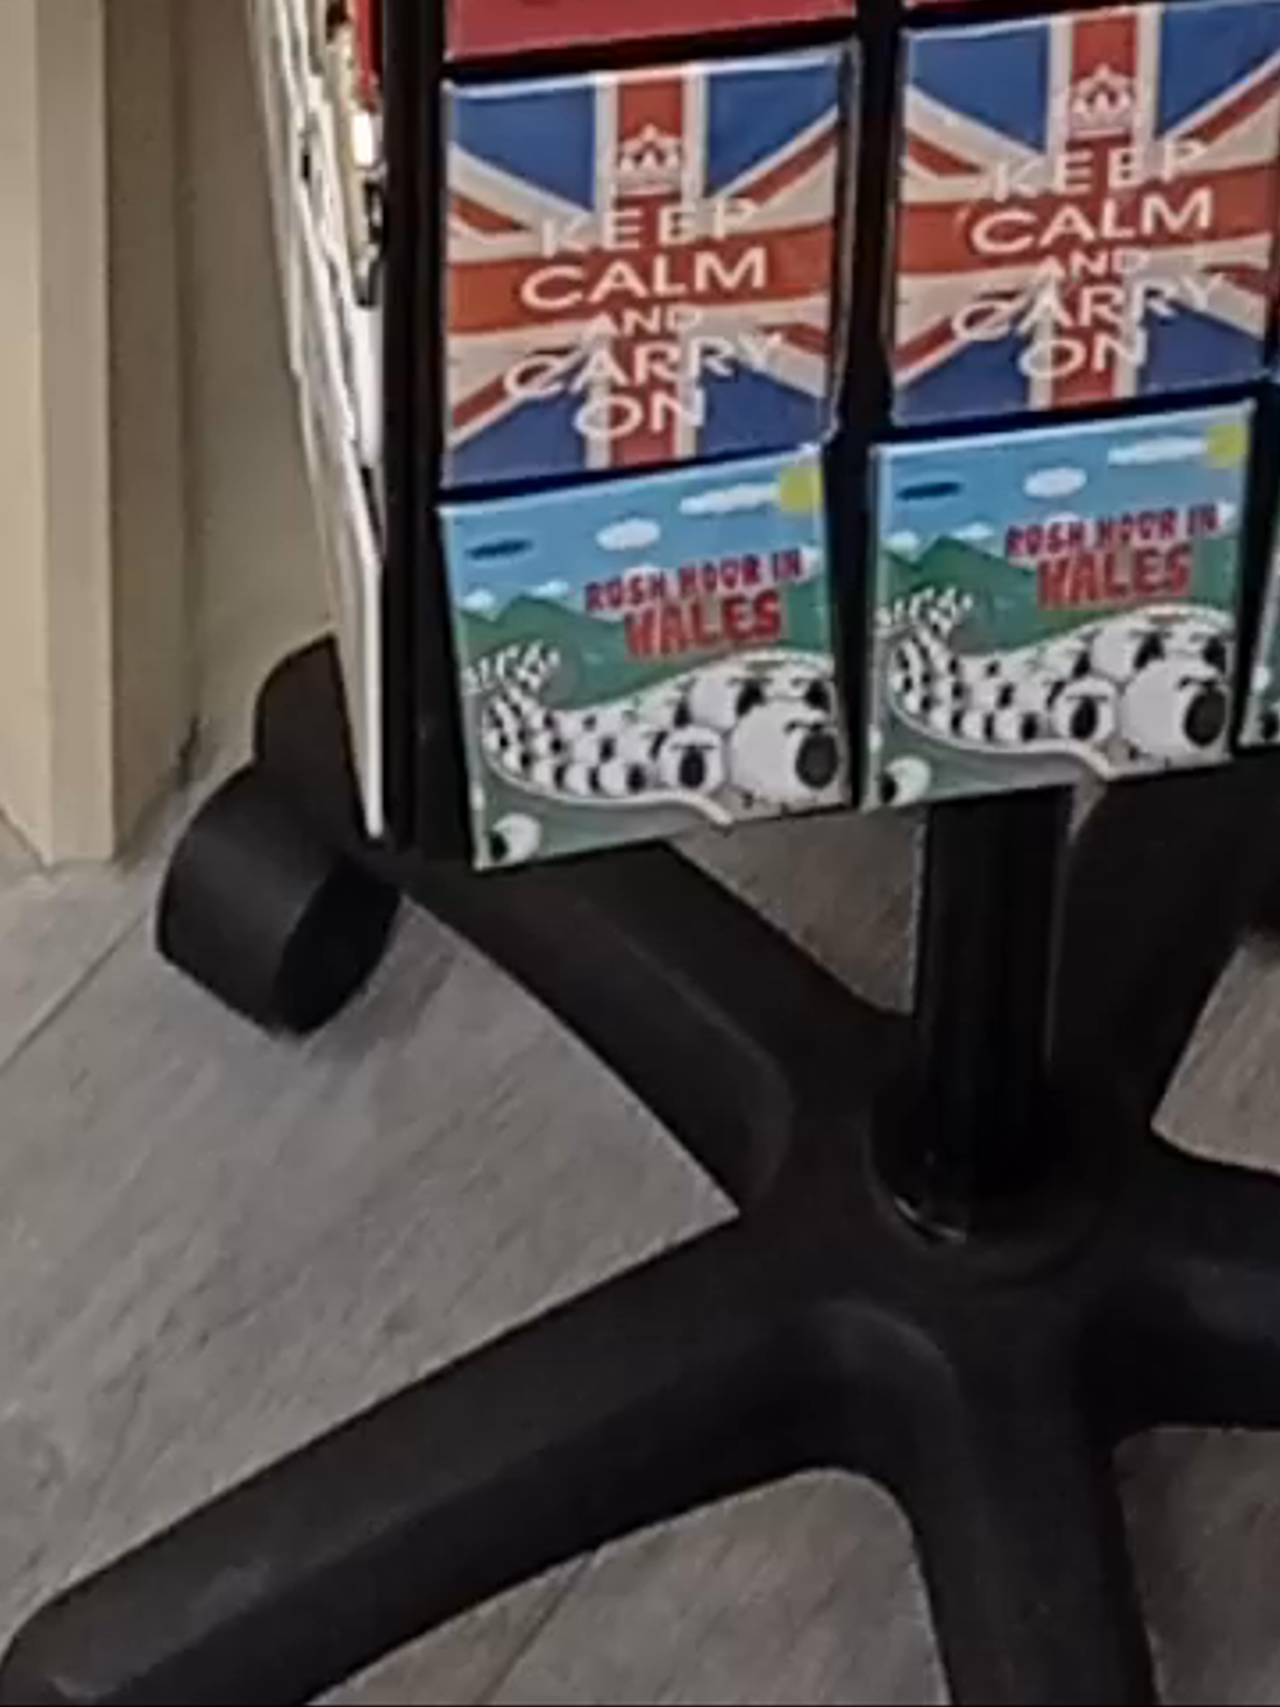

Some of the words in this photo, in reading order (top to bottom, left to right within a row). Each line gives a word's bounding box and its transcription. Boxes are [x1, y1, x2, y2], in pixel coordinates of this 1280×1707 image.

[995, 140, 1211, 201] KEEP
[542, 197, 759, 258] KEEP
[972, 188, 1217, 255] CALM
[521, 247, 769, 309] CALM
[1030, 247, 1155, 283] AND
[581, 305, 708, 338] AND
[951, 273, 1230, 343] CARRY
[503, 330, 788, 402] CARRY
[1020, 329, 1151, 381] ON
[575, 386, 707, 441] ON
[1037, 542, 1192, 606] WALES
[624, 589, 782, 654] WALES
